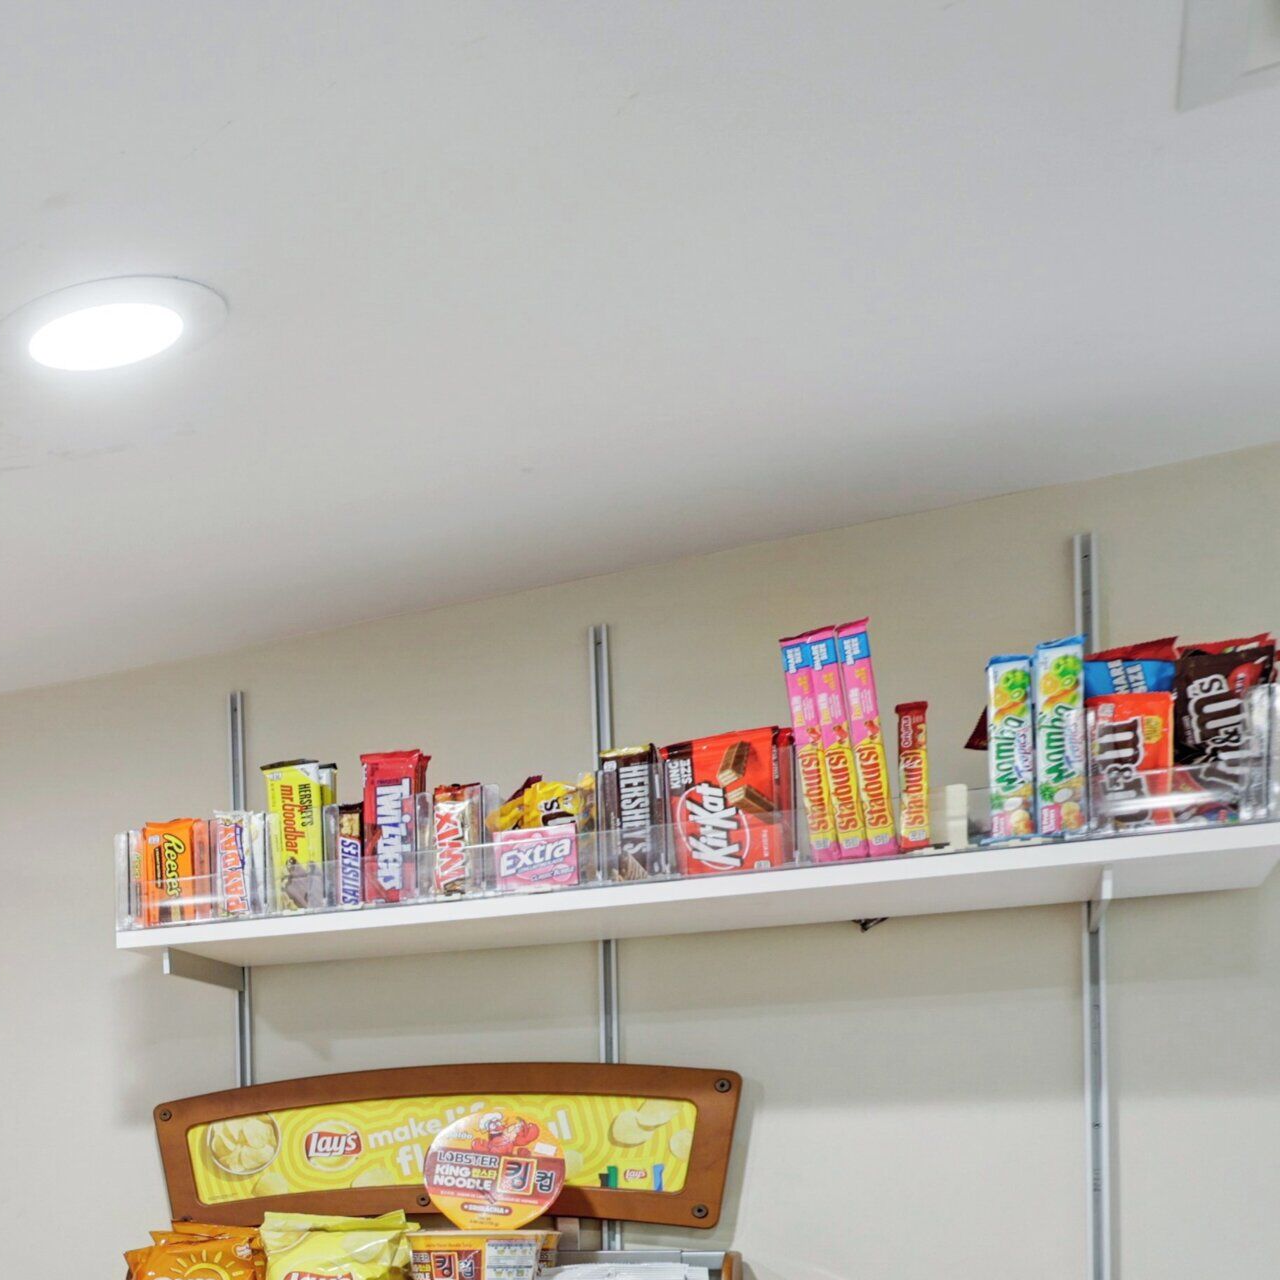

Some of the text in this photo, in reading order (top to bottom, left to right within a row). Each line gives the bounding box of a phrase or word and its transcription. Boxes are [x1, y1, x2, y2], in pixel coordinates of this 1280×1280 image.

[995, 716, 1023, 793] Mamba
[1045, 703, 1075, 782] Mamba
[669, 760, 682, 789] KING
[680, 758, 693, 785] SIZE
[801, 752, 830, 831] Starburst
[827, 750, 859, 831] Starburst
[856, 744, 889, 829] Starburst
[298, 783, 314, 827] HERSHEY'S
[619, 764, 650, 854] HERSHEY'S
[434, 808, 467, 890] TWIX
[501, 838, 571, 877] Extra
[341, 839, 360, 906] SATISFIES
[307, 1132, 359, 1160] Lay's
[367, 1117, 434, 1148] make
[435, 1163, 471, 1178] KING
[436, 1150, 500, 1168] LOBSTER
[432, 1174, 493, 1191] NOODLE
